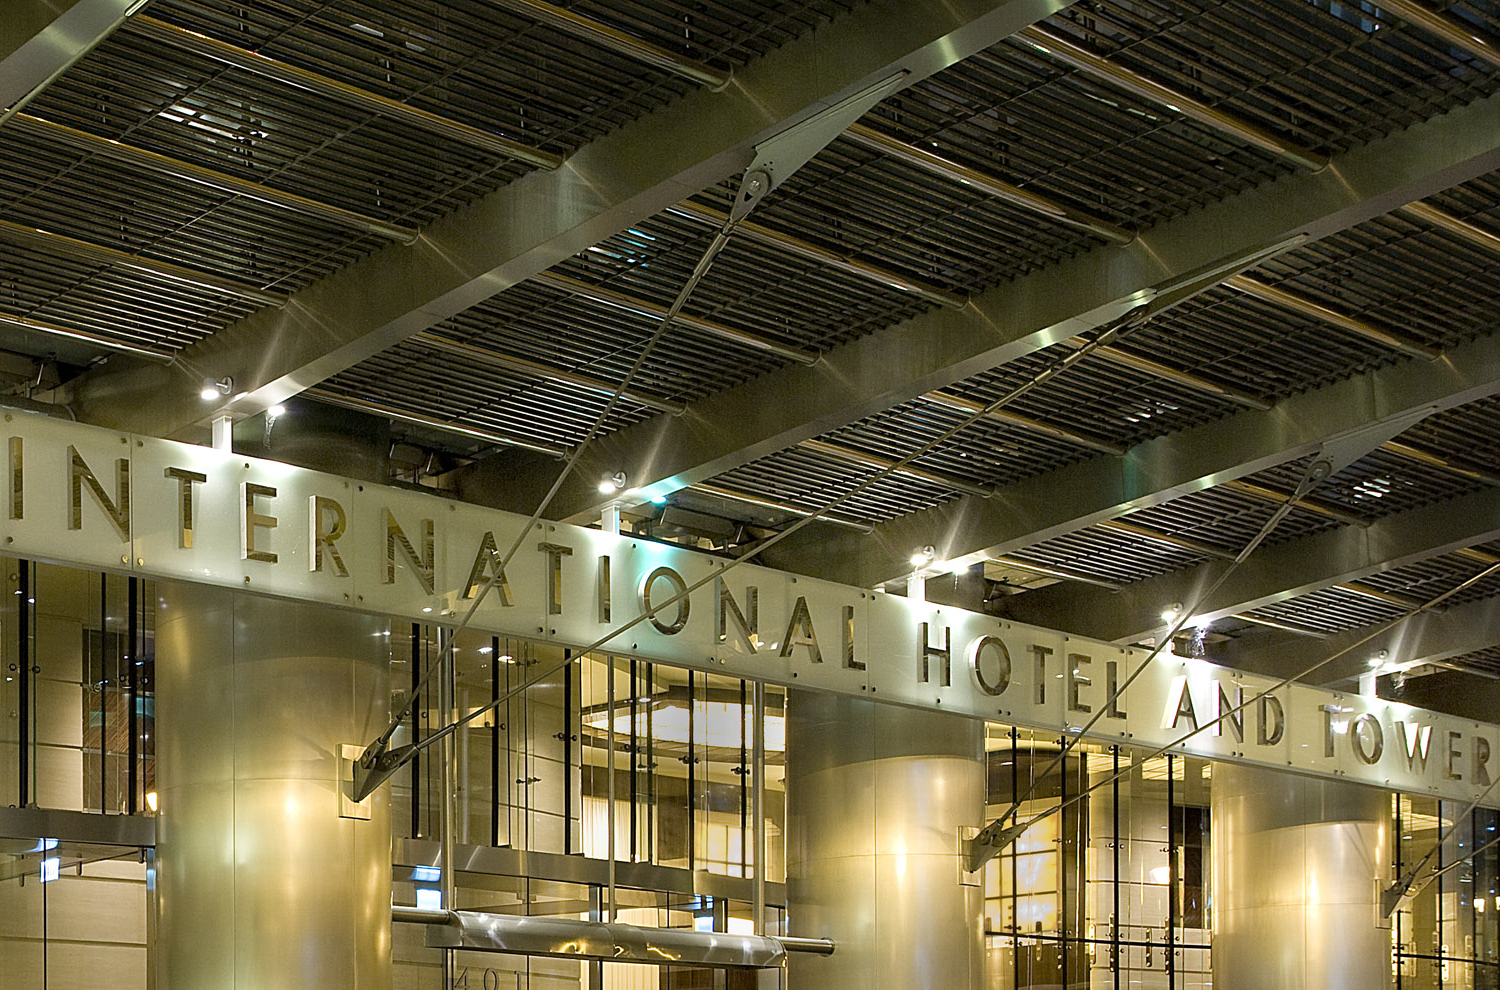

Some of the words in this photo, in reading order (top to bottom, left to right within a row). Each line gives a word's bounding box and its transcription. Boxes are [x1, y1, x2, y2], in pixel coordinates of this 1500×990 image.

[7, 436, 866, 670] INTERNATIONAL
[921, 621, 1128, 720] HOTEL
[1164, 675, 1285, 747] AND
[1318, 704, 1491, 786] TOWER
